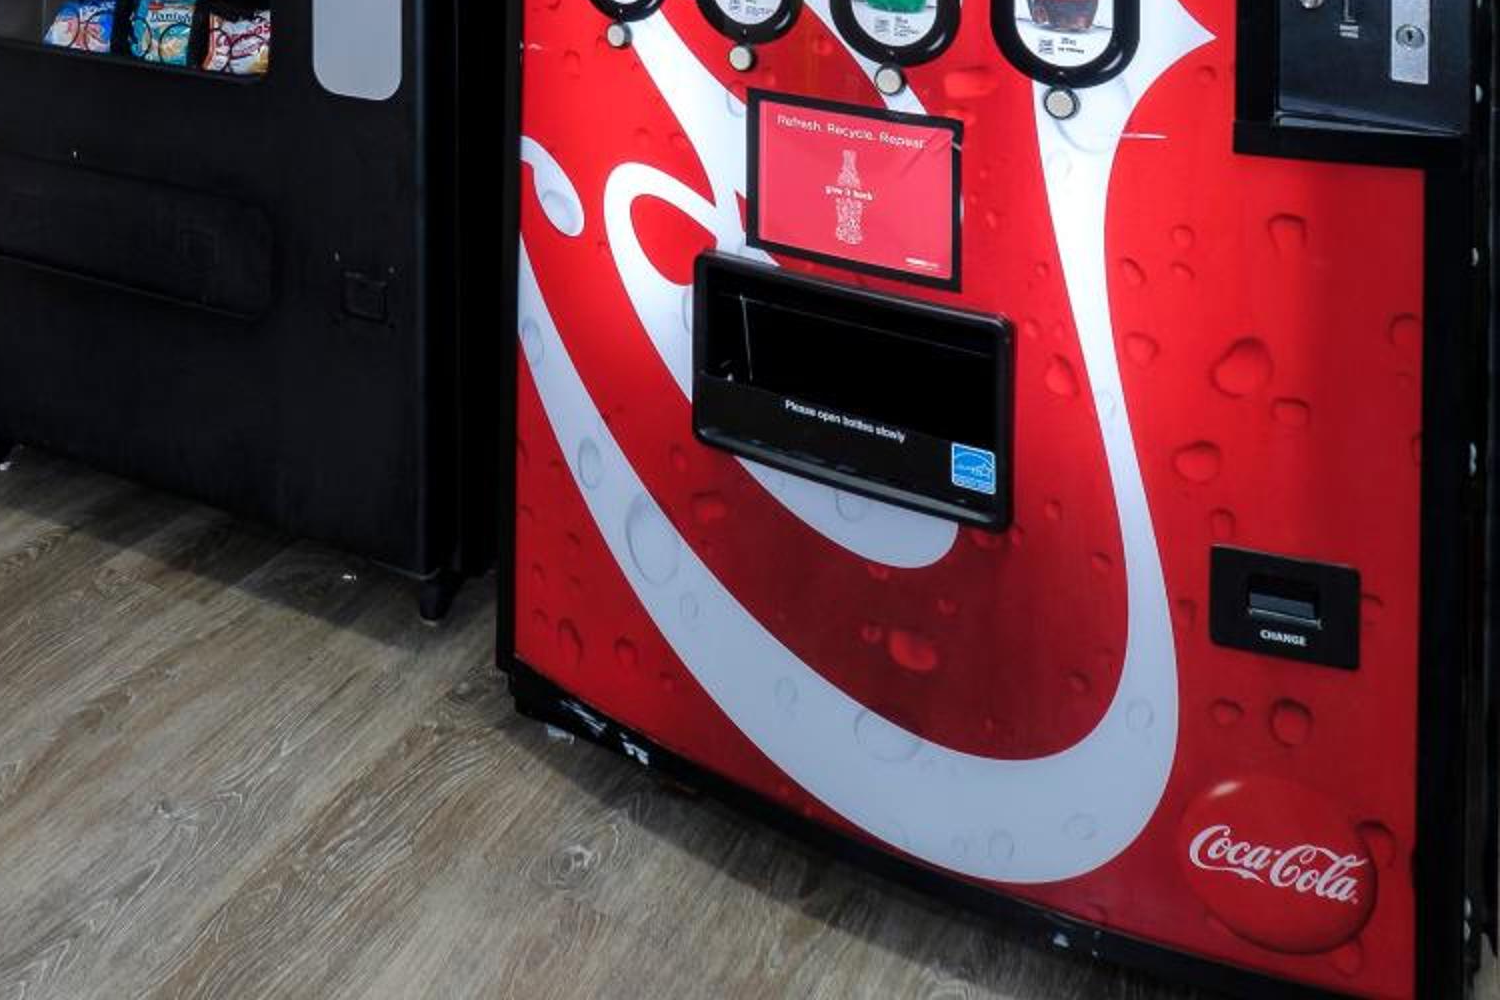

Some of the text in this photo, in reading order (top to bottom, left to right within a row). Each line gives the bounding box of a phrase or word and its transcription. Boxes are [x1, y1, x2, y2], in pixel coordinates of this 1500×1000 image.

[785, 399, 817, 417] Please
[817, 410, 841, 424] open
[875, 426, 905, 444] slowly
[1260, 629, 1307, 646] CHANGE
